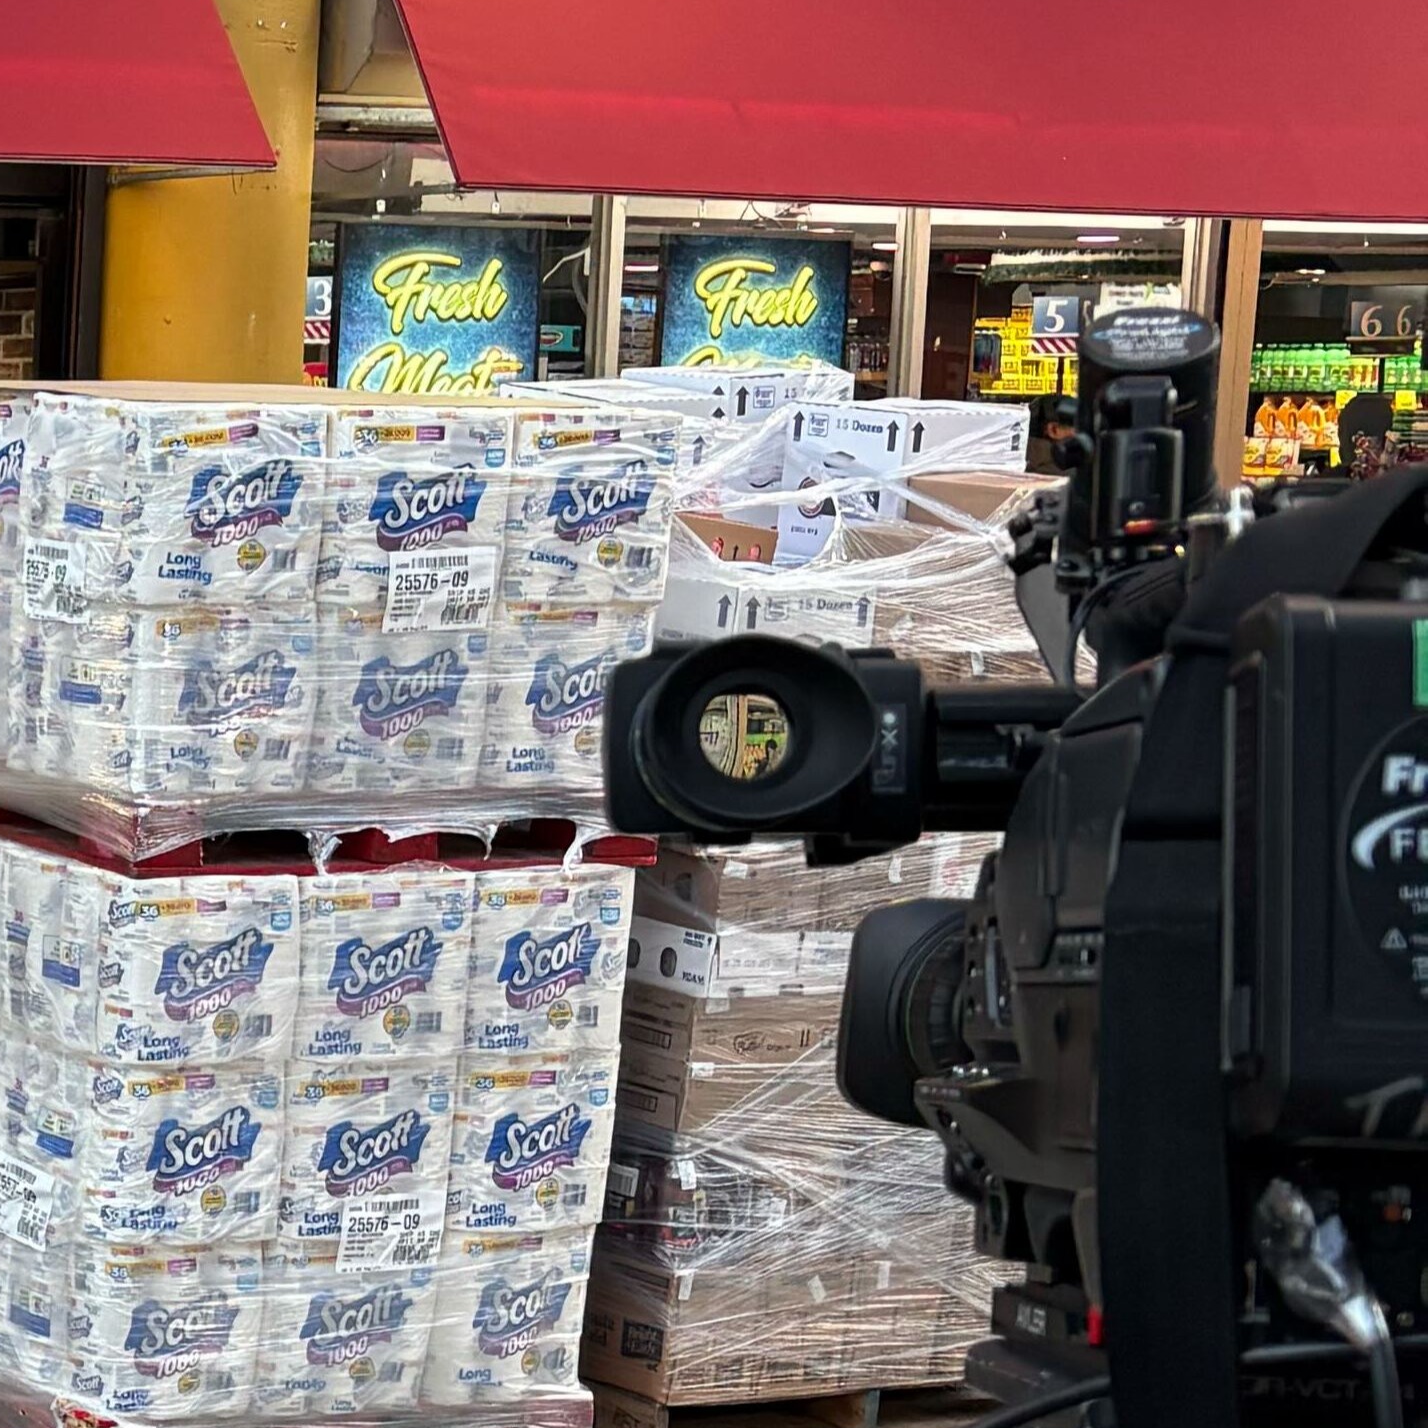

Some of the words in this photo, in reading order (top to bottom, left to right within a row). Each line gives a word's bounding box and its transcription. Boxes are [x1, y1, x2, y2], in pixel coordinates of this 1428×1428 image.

[314, 278, 332, 316] 3
[372, 250, 509, 336] Fresh
[694, 259, 819, 339] Fresh
[1044, 299, 1069, 334] 5
[1359, 304, 1384, 338] 6
[851, 419, 884, 434] Dozen
[198, 458, 289, 524] Scott
[384, 470, 466, 529] Scott
[560, 459, 647, 524] Scott
[399, 523, 443, 552] 1000
[166, 551, 202, 569] Long
[157, 566, 213, 587] Lasting
[395, 569, 470, 591] 25576-09
[366, 648, 453, 712] Scott
[380, 706, 424, 740] 1000
[505, 758, 555, 773] Lasting
[512, 746, 546, 761] Long
[171, 928, 258, 998] Scott
[343, 927, 429, 996] Scott
[511, 922, 591, 989] Scott
[359, 985, 404, 1019] 1000
[524, 980, 567, 1012] 1000
[144, 1034, 181, 1049] Long
[314, 1030, 351, 1045] Long
[477, 1033, 529, 1050] Lasting
[484, 1022, 520, 1039] Long
[137, 1046, 190, 1062] Lasting
[308, 1040, 362, 1057] Lasting
[158, 1107, 246, 1175] Scott
[332, 1112, 417, 1177] Scott
[498, 1104, 580, 1170] Scott
[346, 1166, 391, 1198] 1000
[512, 1160, 555, 1192] 1000
[304, 1211, 340, 1227] Long
[347, 1213, 421, 1234] 25576-09
[465, 1212, 518, 1228] Lasting
[471, 1201, 507, 1216] Long
[297, 1223, 342, 1237] Lastin
[314, 1281, 395, 1346] Scott
[325, 1333, 369, 1368] 1000
[458, 1367, 492, 1382] Long
